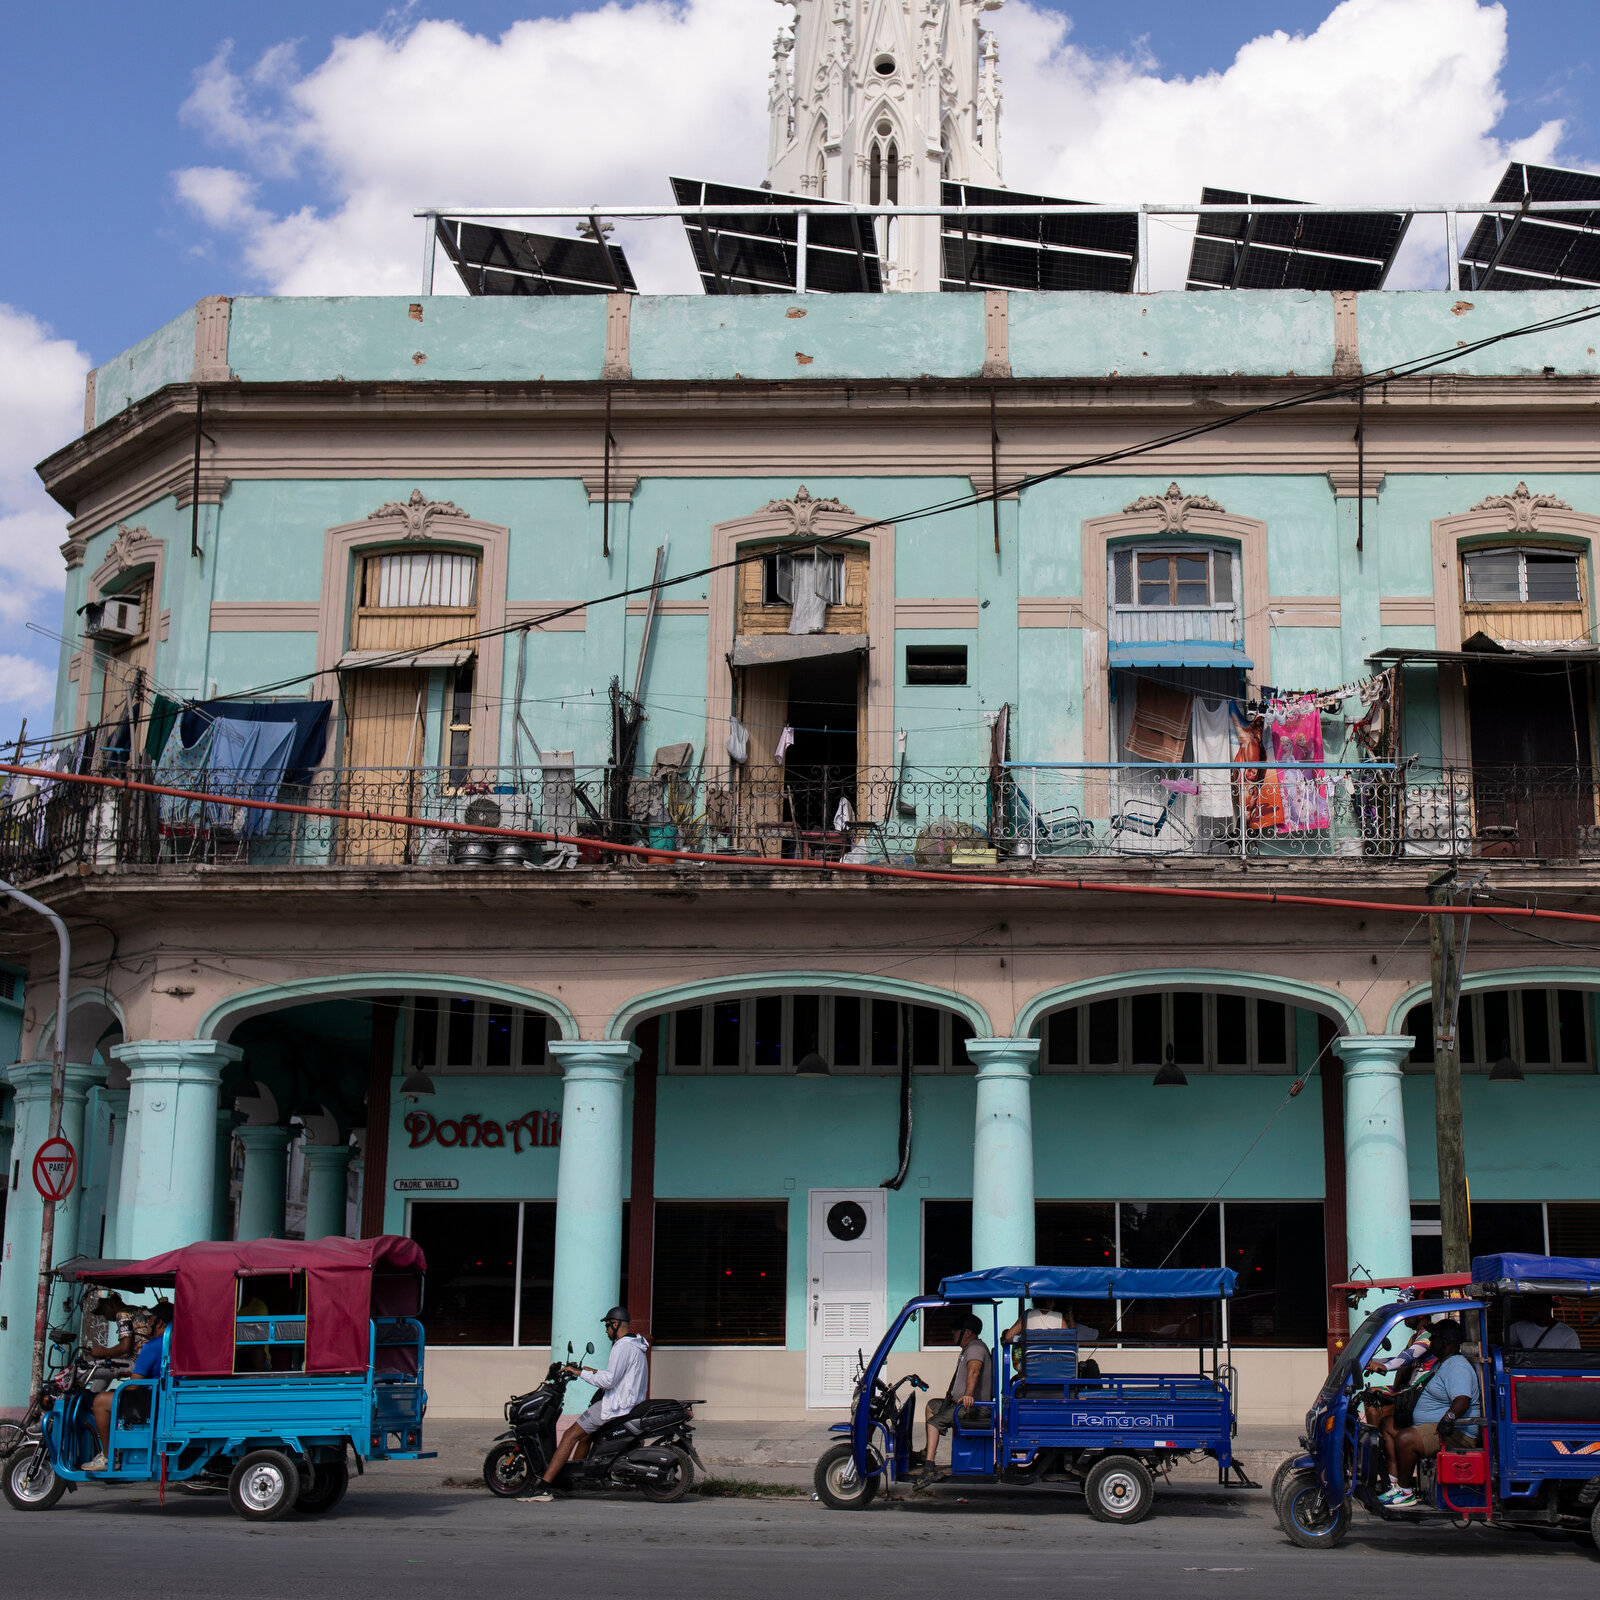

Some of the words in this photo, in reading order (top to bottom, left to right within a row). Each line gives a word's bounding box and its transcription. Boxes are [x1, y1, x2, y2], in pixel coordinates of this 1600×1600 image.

[404, 1111, 504, 1148] Doña
[505, 1109, 562, 1154] Ali
[49, 1163, 64, 1172] PARE
[399, 1180, 422, 1189] PADRE
[425, 1180, 453, 1189] VARELA
[1071, 1412, 1175, 1429] Fengchi
